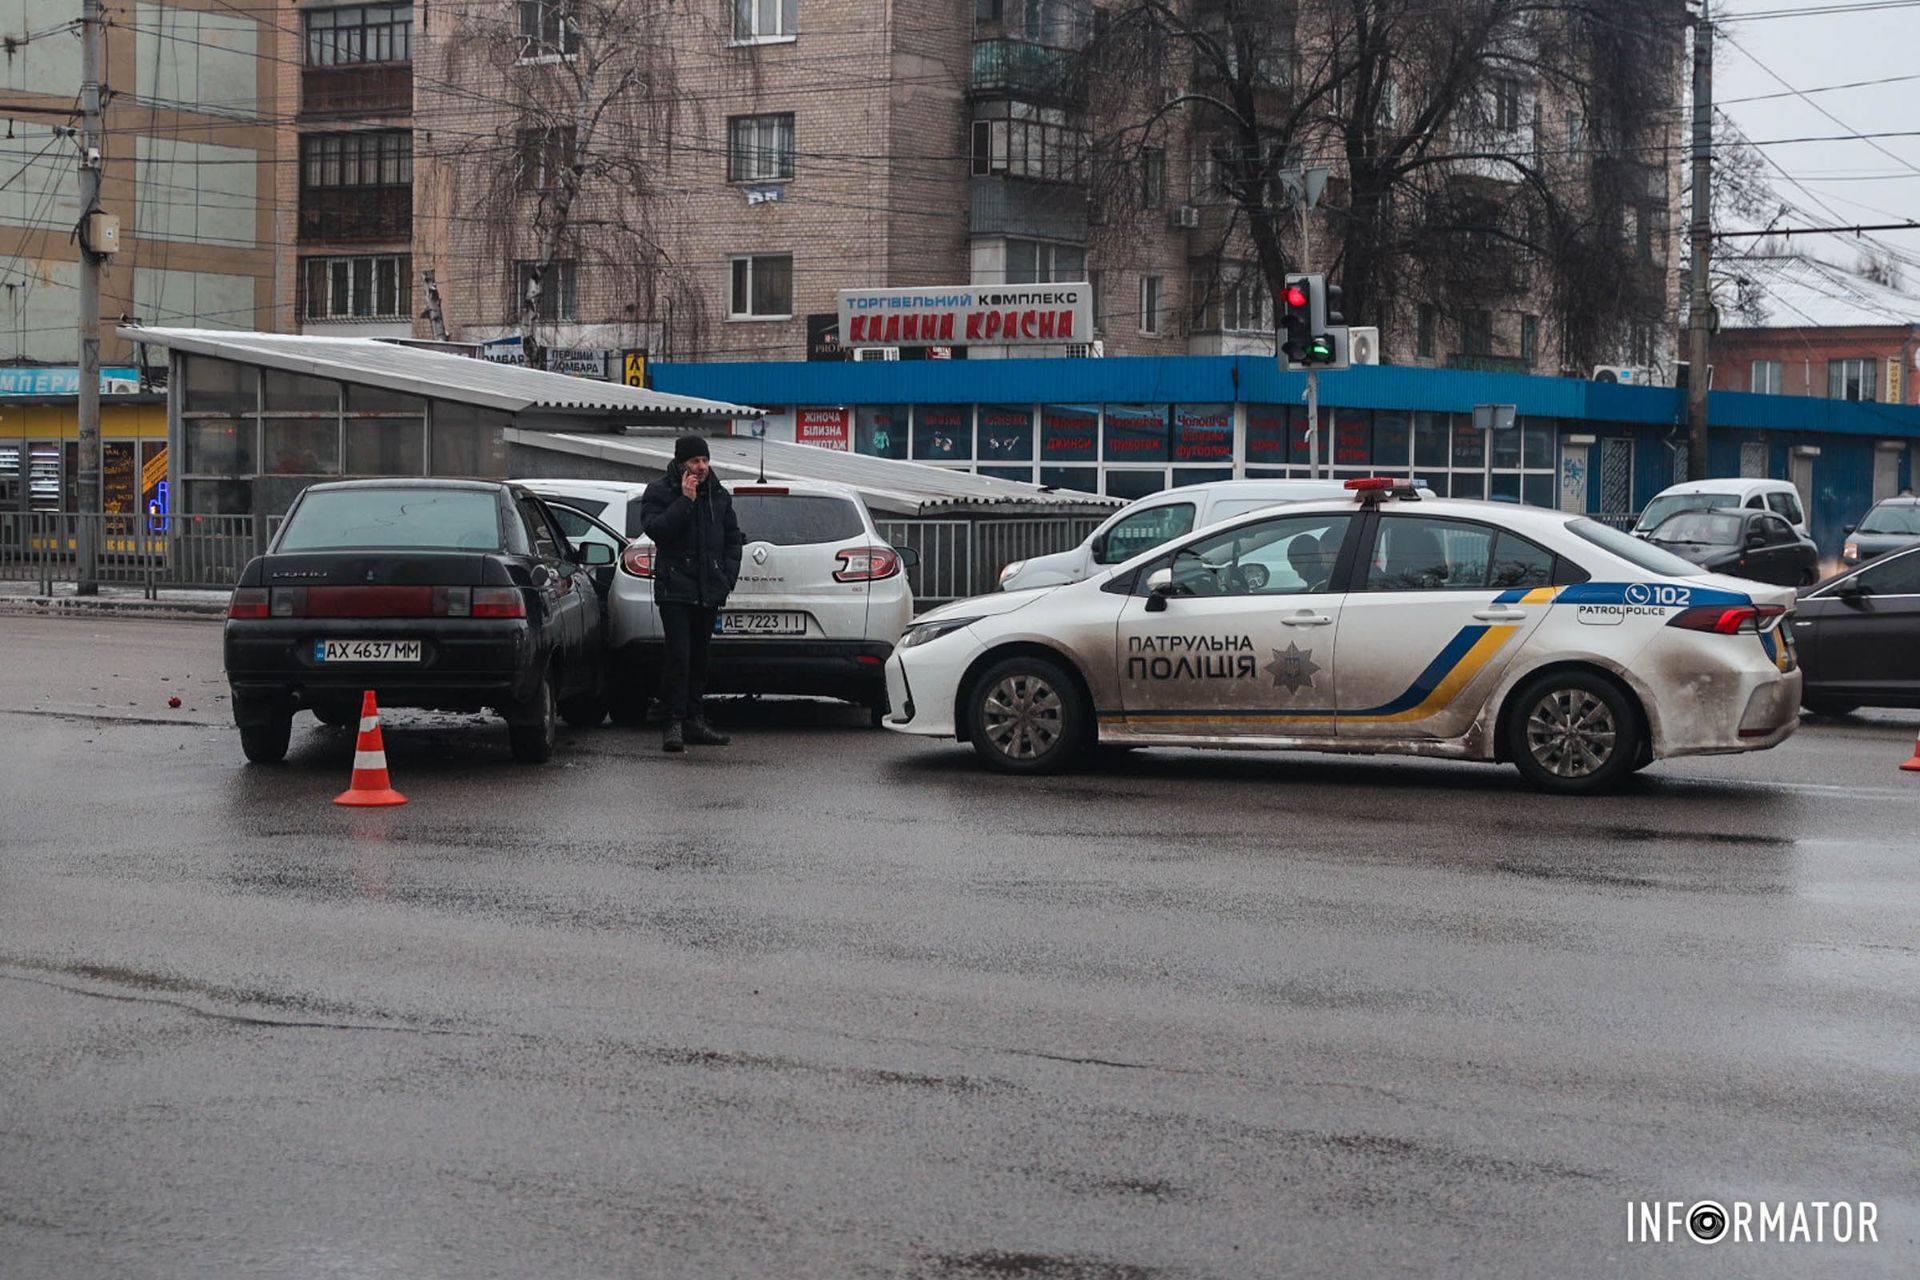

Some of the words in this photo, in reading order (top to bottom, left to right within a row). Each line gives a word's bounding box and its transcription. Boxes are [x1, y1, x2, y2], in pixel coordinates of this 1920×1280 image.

[846, 294, 972, 309] ТОРГІВЕЛЬНИЙ
[978, 292, 1078, 306] КОМПЛЕКС
[849, 312, 956, 342] КАЛИНА
[965, 309, 1075, 340] КРАСНА
[804, 411, 841, 422] ЖІНОЧА
[803, 425, 842, 436] БІЛИЗНА
[1654, 586, 1691, 605] 102
[1579, 605, 1622, 615] PATROL
[1626, 607, 1665, 616] POLICE
[724, 615, 743, 628] AE
[747, 615, 779, 628] 7223
[326, 642, 349, 659] AX
[353, 642, 391, 659] 4637
[395, 642, 420, 659] MM
[1128, 635, 1254, 651] ПАТРУЛЬНА
[1128, 656, 1256, 680] ПОЛІЦІЯ
